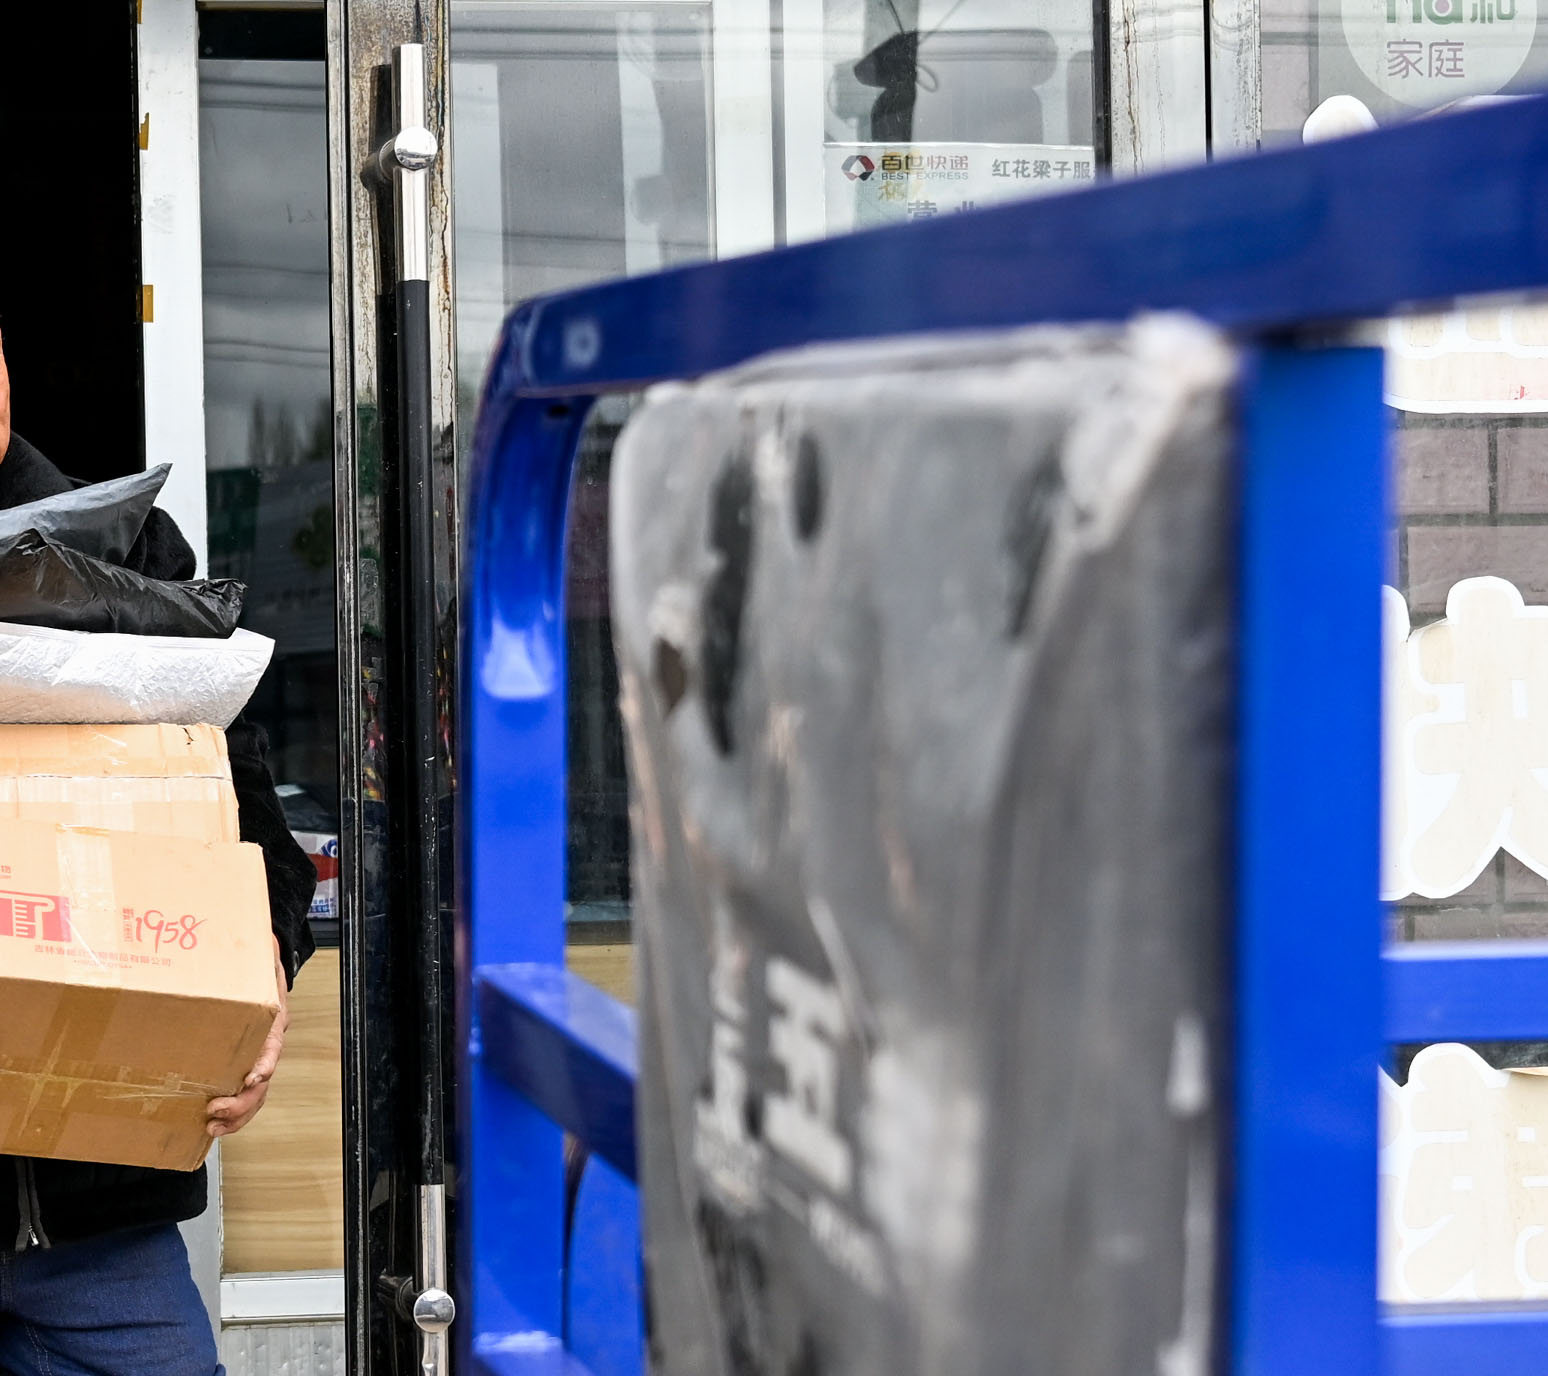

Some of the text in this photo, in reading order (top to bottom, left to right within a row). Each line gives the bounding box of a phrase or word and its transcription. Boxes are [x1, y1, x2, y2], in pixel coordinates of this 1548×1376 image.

[1386, 40, 1466, 80] 家庭
[881, 154, 969, 171] 百世快递
[991, 159, 1096, 180] 红花梁子服
[881, 171, 969, 181] BEST EXPRESS
[134, 909, 209, 954] 1958
